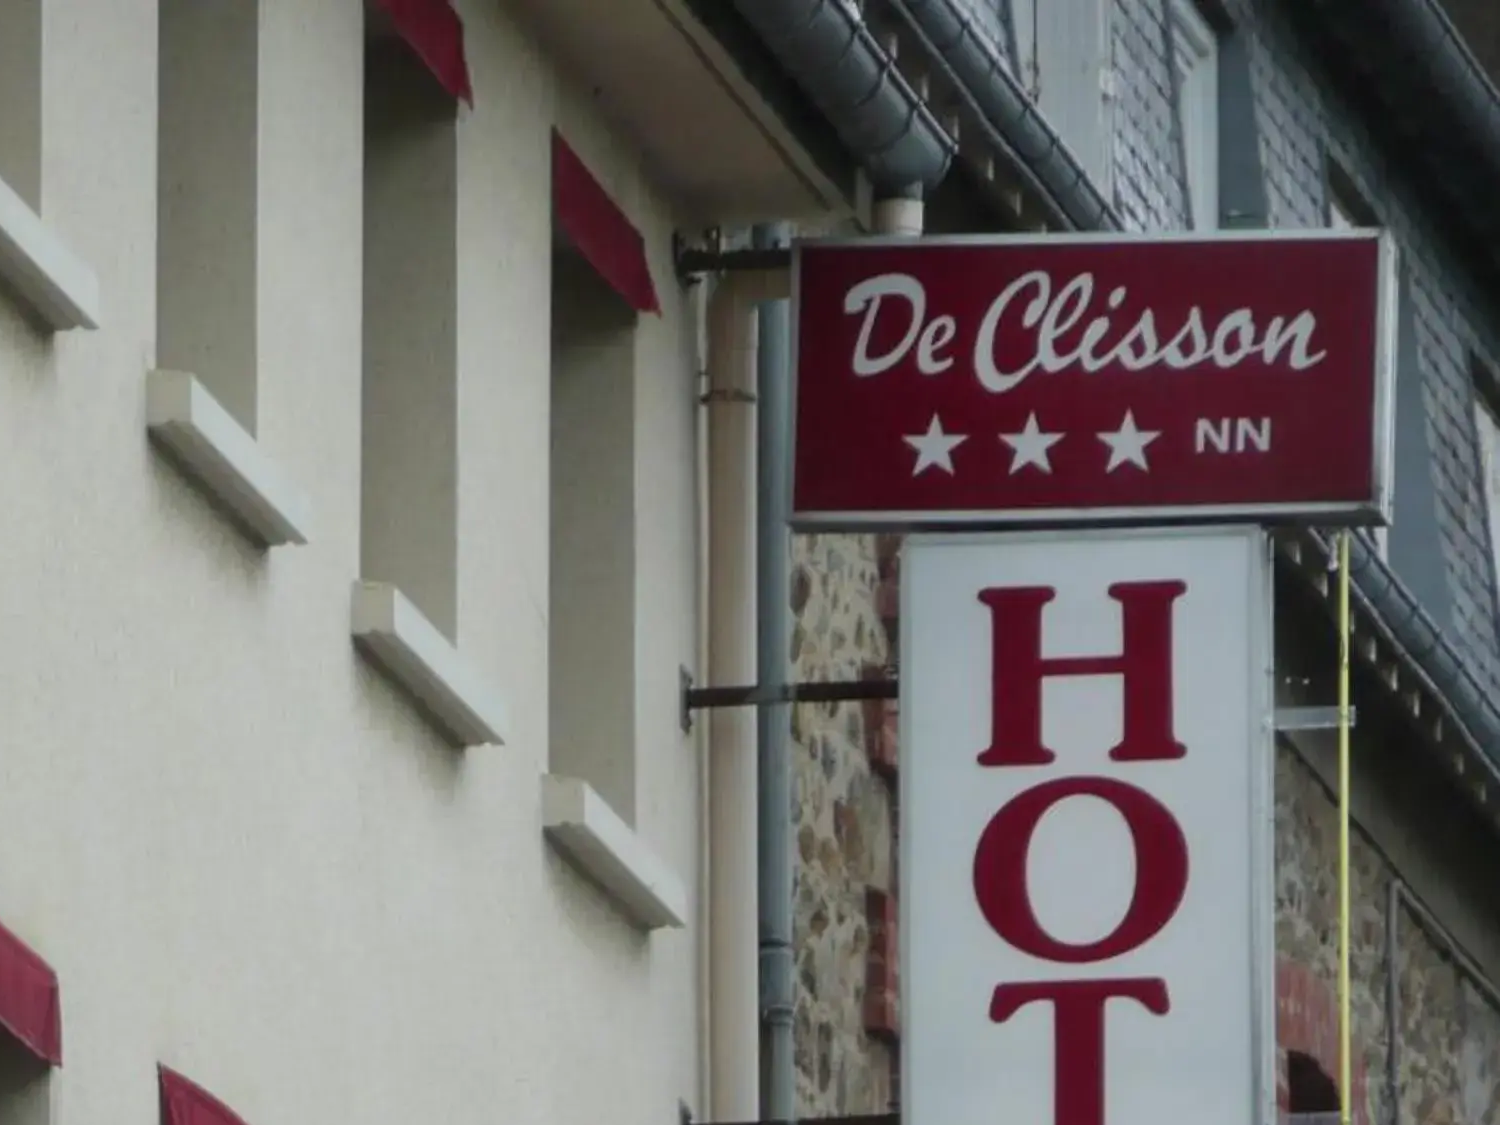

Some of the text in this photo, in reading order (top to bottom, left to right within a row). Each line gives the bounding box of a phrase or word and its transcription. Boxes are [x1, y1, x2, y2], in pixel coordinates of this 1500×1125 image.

[844, 270, 1327, 393] De Clisson
[1195, 417, 1271, 453] NN
